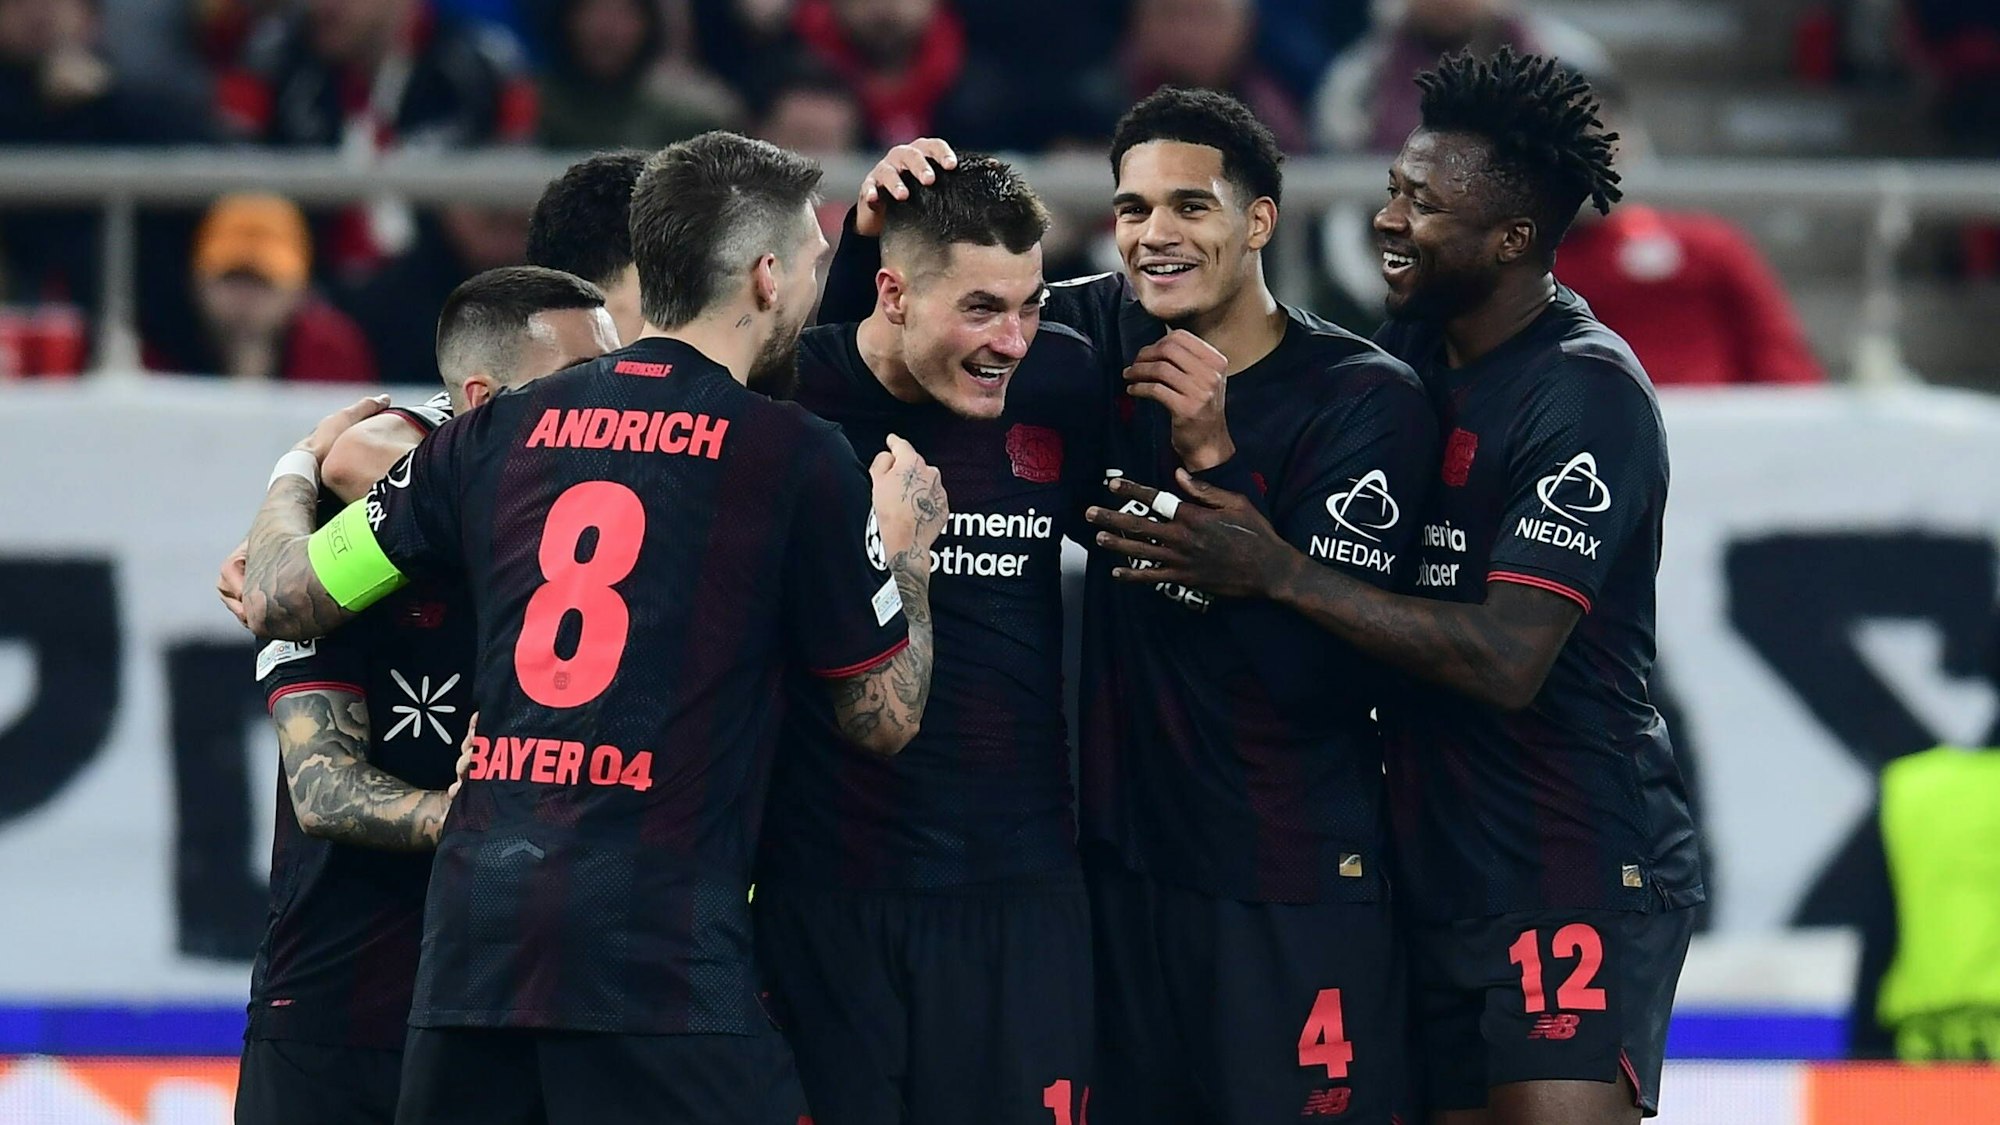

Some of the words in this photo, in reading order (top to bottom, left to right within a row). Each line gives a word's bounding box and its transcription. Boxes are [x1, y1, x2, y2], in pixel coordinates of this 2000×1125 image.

[525, 408, 730, 460] ANDRICH
[939, 507, 1053, 539] rmenia
[1515, 517, 1602, 560] NIEDAX
[928, 545, 1030, 578] othaer
[1309, 535, 1397, 575] NIEDAX
[514, 480, 646, 708] 8
[469, 736, 586, 786] BAYER
[589, 744, 653, 792] 04
[1508, 923, 1607, 1013] 12
[1298, 988, 1353, 1079] 4
[1043, 1079, 1089, 1125] 1
